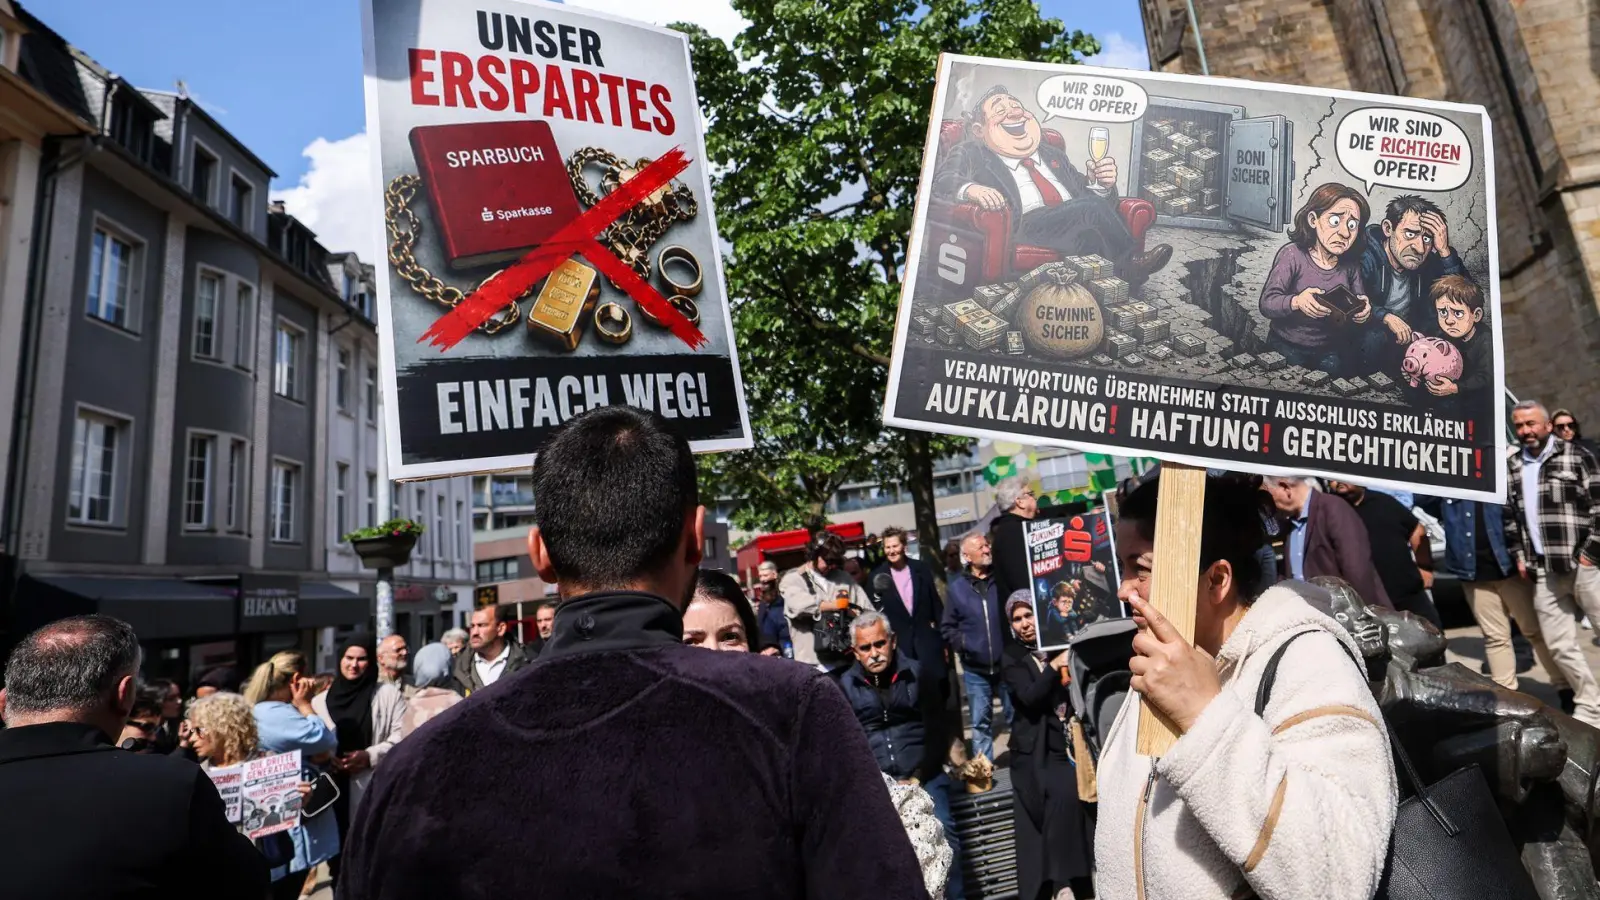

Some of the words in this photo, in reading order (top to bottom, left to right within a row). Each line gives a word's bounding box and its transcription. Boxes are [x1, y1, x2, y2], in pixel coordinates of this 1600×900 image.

[476, 10, 604, 67] UNSER
[408, 48, 675, 136] ERSPARTES
[1063, 81, 1088, 95] WIR
[1093, 84, 1124, 98] SIND
[1047, 95, 1084, 110] AUCH
[1089, 99, 1137, 115] OPFER!
[1369, 115, 1399, 133] WIR
[1405, 119, 1442, 137] SIND
[1349, 133, 1375, 150] DIE
[1380, 137, 1460, 161] RICHTIGEN
[446, 146, 544, 168] SPARBUCH
[1236, 149, 1265, 166] BONI
[1231, 168, 1270, 186] SICHER
[1373, 159, 1437, 182] OPFER!
[496, 204, 552, 221] Sparkasse
[1036, 305, 1096, 322] GEWINNE
[1042, 323, 1089, 341] SICHER
[436, 374, 609, 434] EINFACH
[621, 372, 712, 418] WEG!
[944, 359, 1098, 396] VERANTWORTUNG
[1105, 375, 1215, 409] ÜBERNEHMEN
[1221, 393, 1269, 416] STATT
[1275, 400, 1377, 429] AUSSCHLUSS
[1383, 412, 1474, 442] ERKLÄREN!
[925, 383, 1118, 434] AUFKLÄRUNG!
[1130, 407, 1271, 453] HAFTUNG!
[1283, 426, 1482, 478] GERECHTIGKEIT!
[1030, 525, 1061, 544] ZUKUNFT
[1031, 519, 1050, 531] MEINE
[1034, 544, 1044, 553] IST
[1044, 540, 1058, 550] WEG
[1041, 548, 1059, 559] EINER
[1032, 556, 1061, 575] NACHT.
[247, 761, 297, 780] GENERATION
